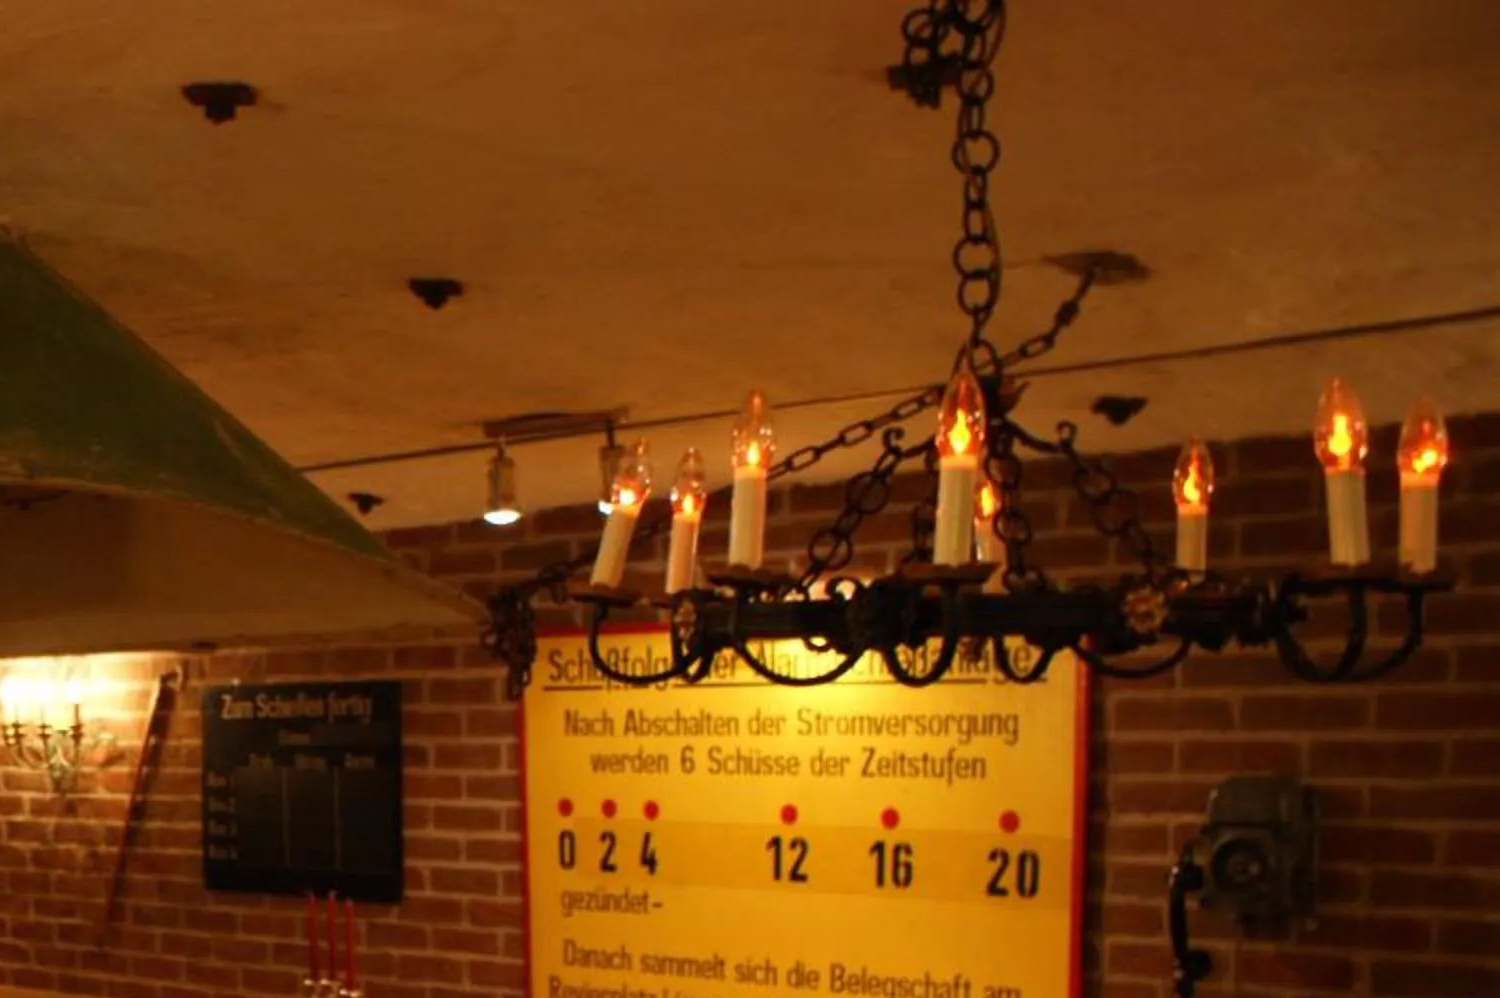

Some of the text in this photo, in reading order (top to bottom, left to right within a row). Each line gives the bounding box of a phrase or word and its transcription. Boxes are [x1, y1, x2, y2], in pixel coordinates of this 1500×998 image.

[563, 707, 1020, 746] Nach Abschalten der Stromversorgung
[590, 745, 988, 788] werden 6 Schüsse der Zeitstufen
[558, 829, 1040, 899] 0 2 4 12 16 20
[563, 938, 633, 971] Danach
[640, 952, 727, 982] sammelt
[734, 957, 779, 987] sich
[786, 960, 821, 991] die
